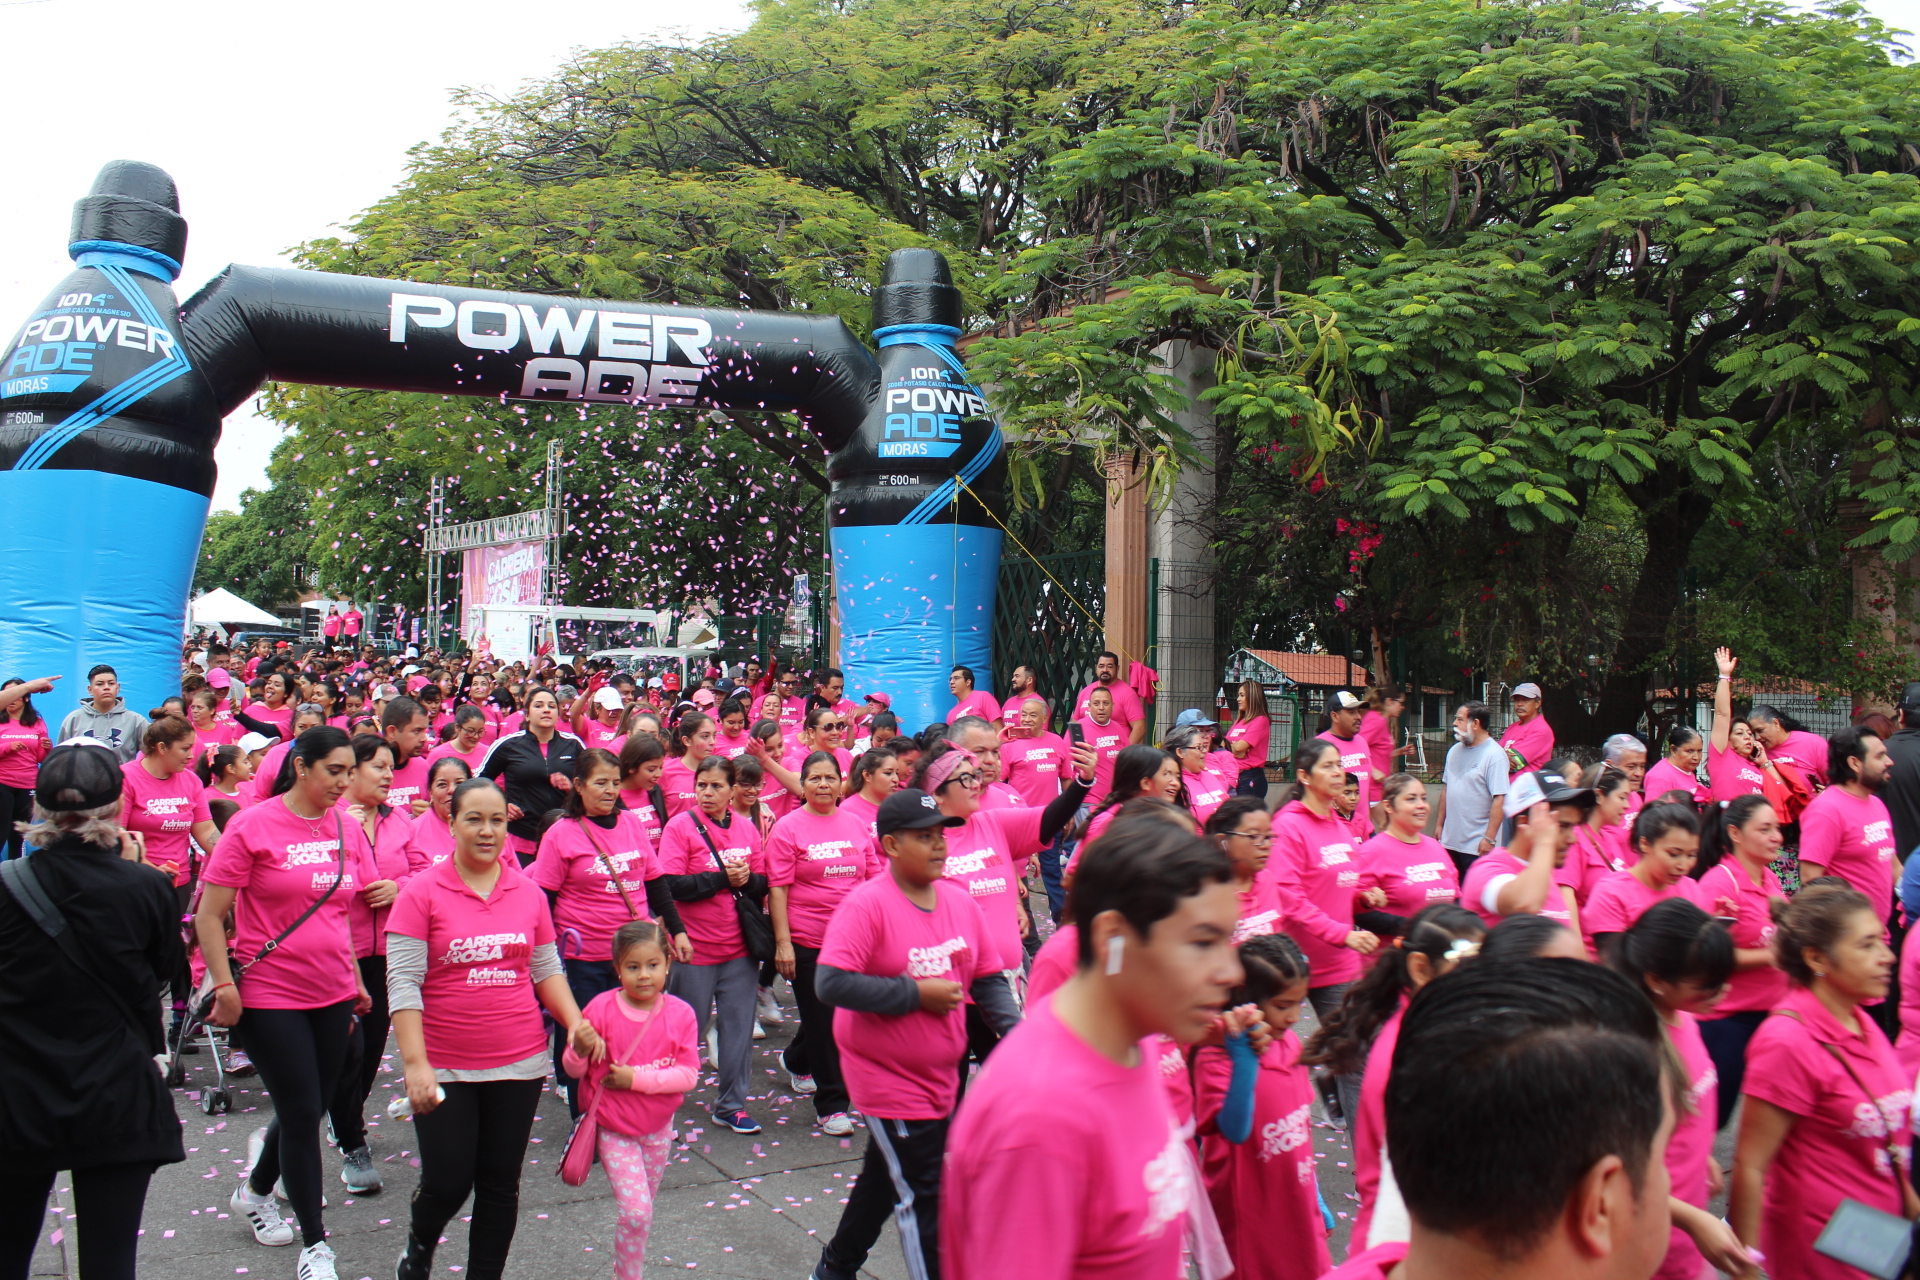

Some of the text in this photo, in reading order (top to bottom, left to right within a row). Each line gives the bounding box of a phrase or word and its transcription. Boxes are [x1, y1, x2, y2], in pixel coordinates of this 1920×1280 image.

[18, 315, 175, 360] POWER
[389, 292, 712, 366] POWER
[8, 341, 96, 376] ADE
[6, 377, 49, 396] MORAS
[519, 357, 704, 406] ADE
[884, 413, 962, 440] ADE
[883, 443, 928, 456] MORAS
[488, 545, 535, 585] CARRERA
[388, 786, 419, 798] ARRERA
[147, 797, 189, 807] CARRERA
[147, 805, 180, 815] ROSA
[808, 840, 853, 852] CARRERA
[808, 848, 843, 860] ROSA
[287, 851, 333, 866] ROSA
[945, 847, 996, 866] CARRERA
[823, 865, 857, 875] Adriana
[945, 859, 987, 876] ROSA
[969, 877, 1007, 892] Adriana
[449, 933, 527, 951] CARRERA
[446, 945, 531, 964] ROSA 2019
[467, 967, 517, 982] Adriana
